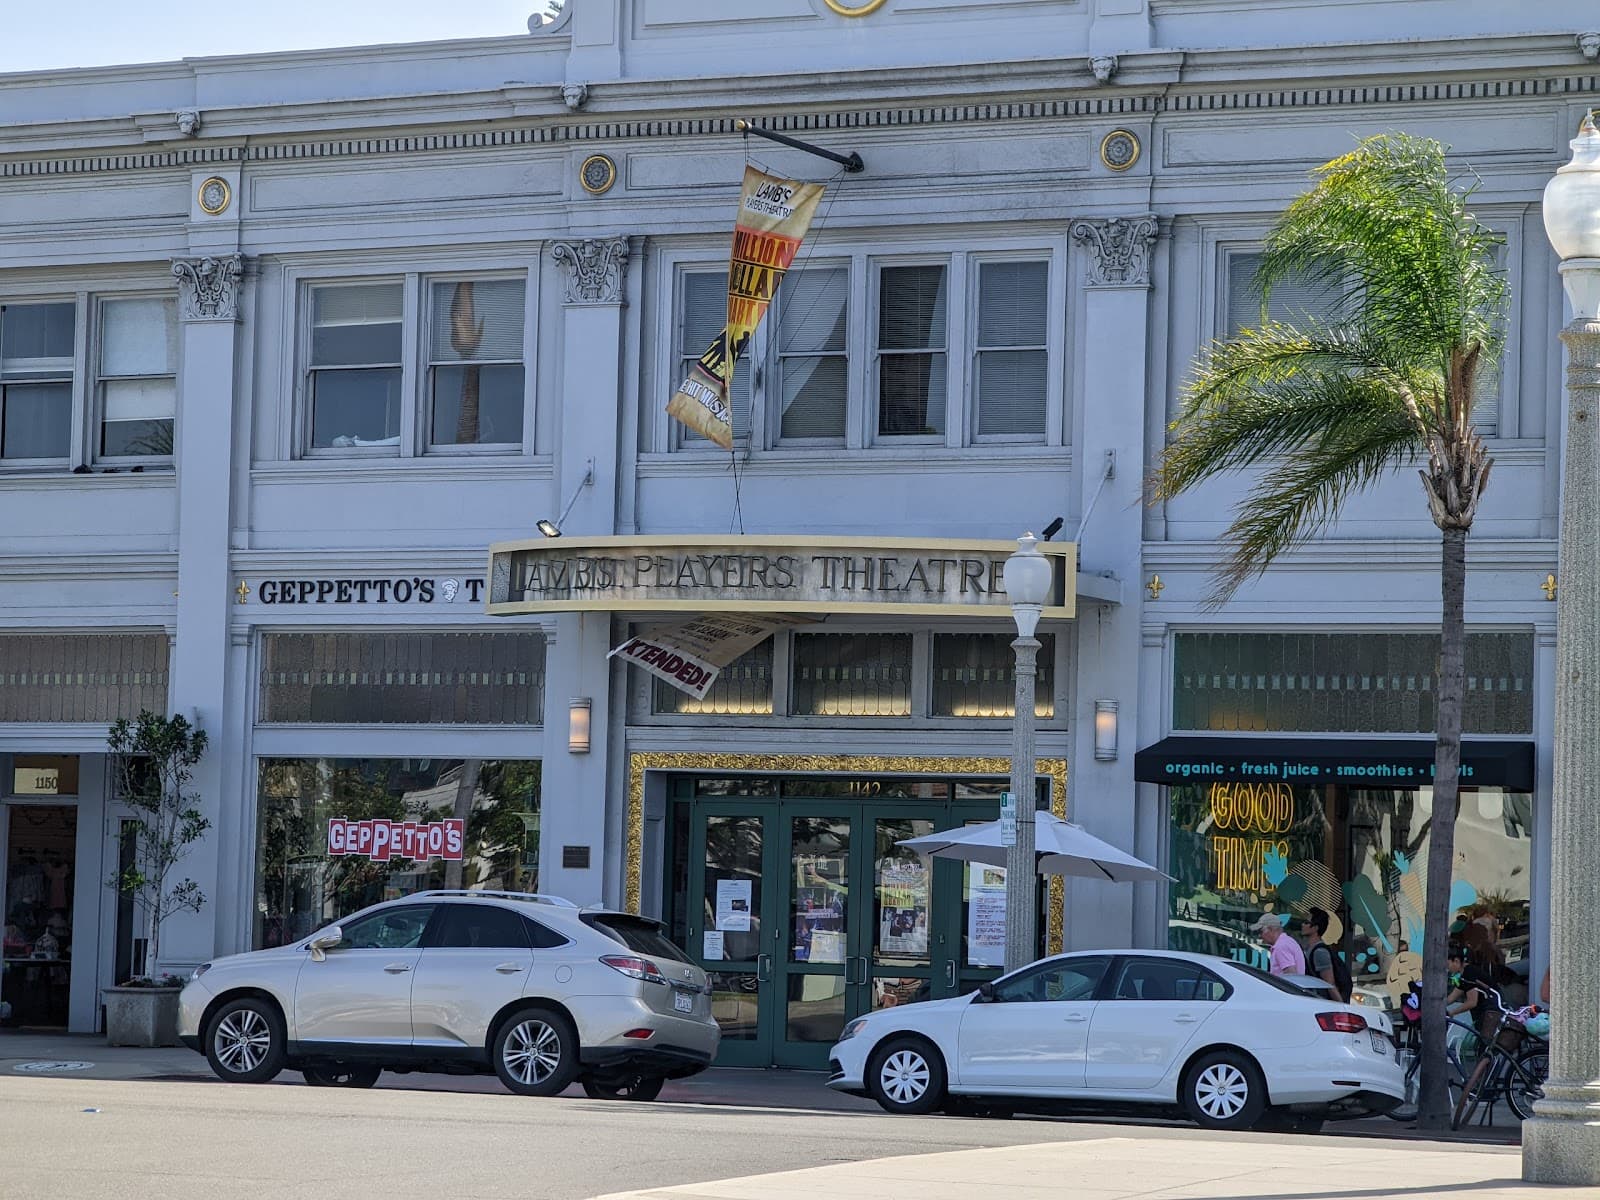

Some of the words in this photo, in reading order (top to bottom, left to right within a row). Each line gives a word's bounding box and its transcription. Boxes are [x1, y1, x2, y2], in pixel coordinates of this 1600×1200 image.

[733, 231, 796, 269] MILLION
[631, 555, 797, 588] PLAYERS
[812, 556, 1007, 594] THEATRE
[258, 577, 435, 605] GEPPETTO'S
[35, 776, 58, 790] 1150
[1165, 762, 1225, 777] organic
[1241, 762, 1278, 775] fresh
[1282, 761, 1319, 779] juice
[1337, 764, 1414, 777] smoothies
[850, 781, 881, 798] 1142
[1211, 782, 1294, 834] GOOD
[329, 822, 462, 857] GEPPETTO'S
